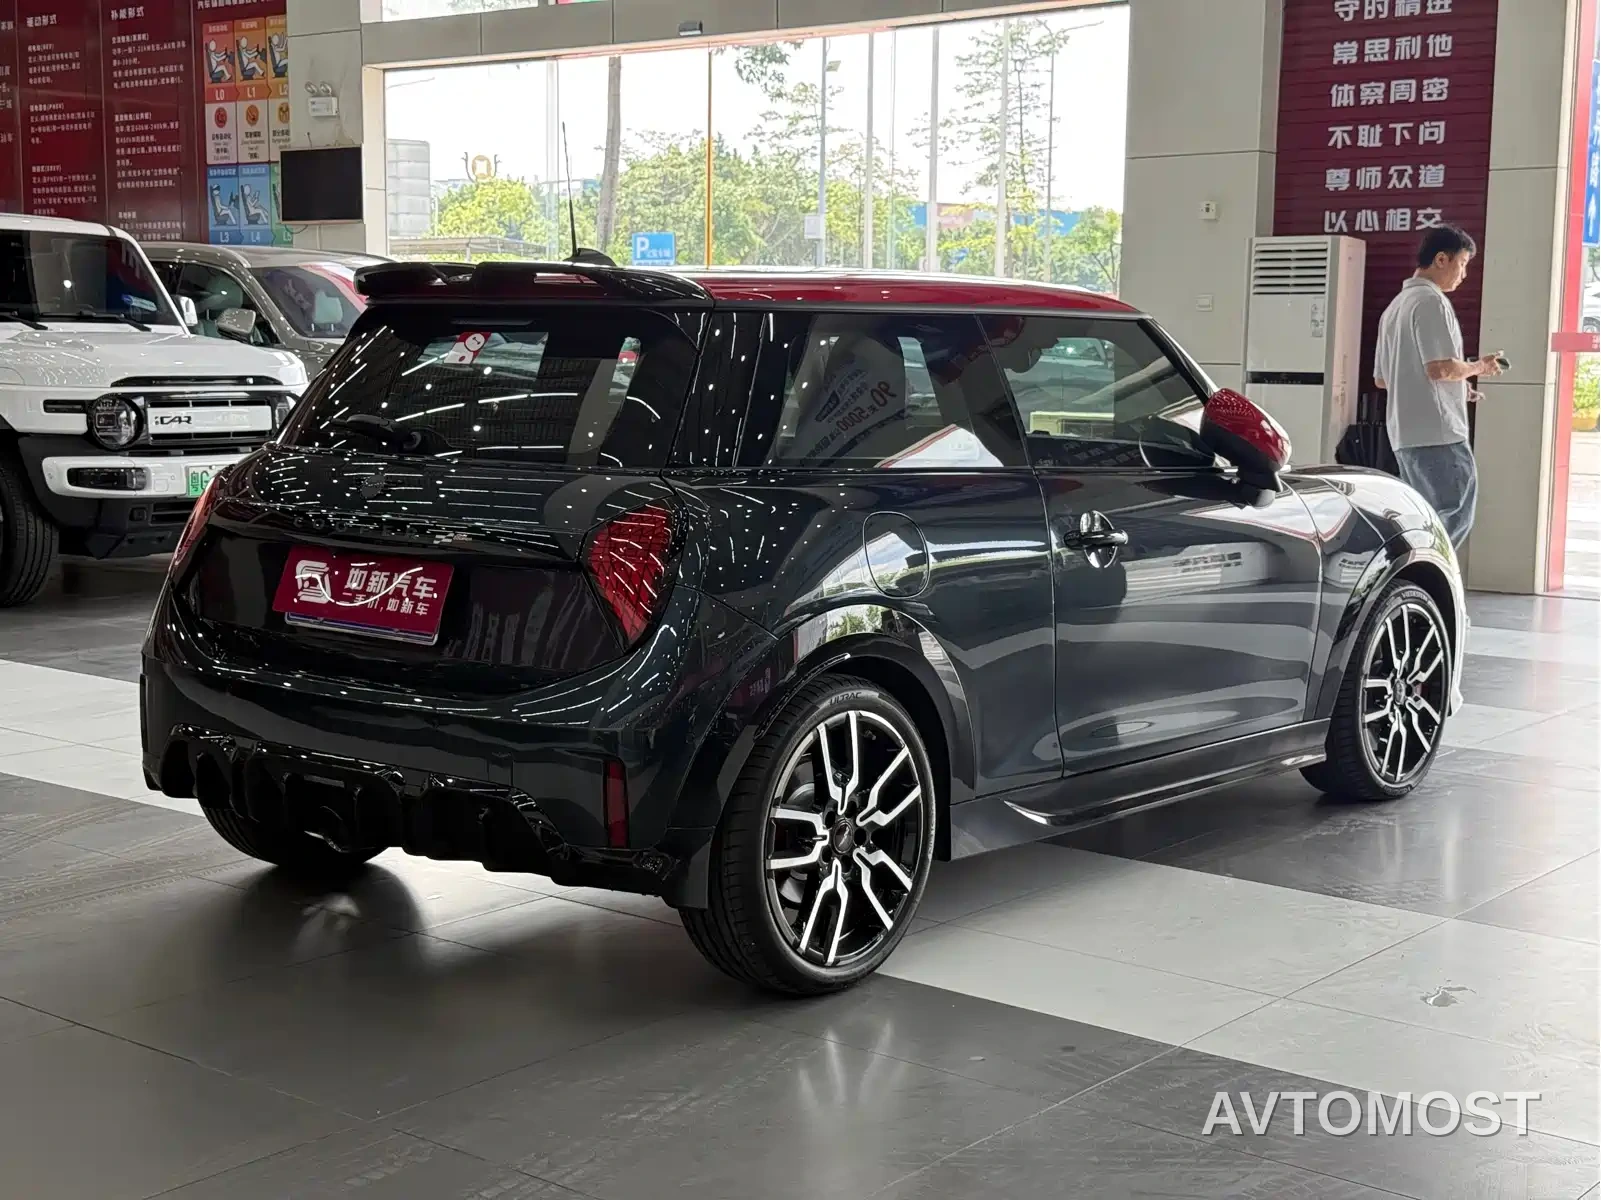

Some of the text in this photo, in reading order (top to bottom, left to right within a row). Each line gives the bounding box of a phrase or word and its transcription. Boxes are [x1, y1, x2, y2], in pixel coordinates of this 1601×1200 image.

[1332, 34, 1453, 65] 常思利他
[215, 89, 225, 100] L0
[247, 87, 256, 98] L1
[1330, 77, 1449, 108] 体察周密
[1327, 121, 1446, 149] 不耻下问
[1325, 164, 1446, 191] 尊师众道
[1324, 207, 1443, 232] 以心相交
[220, 232, 230, 243] L3
[251, 232, 260, 242] L4
[636, 236, 650, 259] P
[344, 567, 437, 600] 如新汽车
